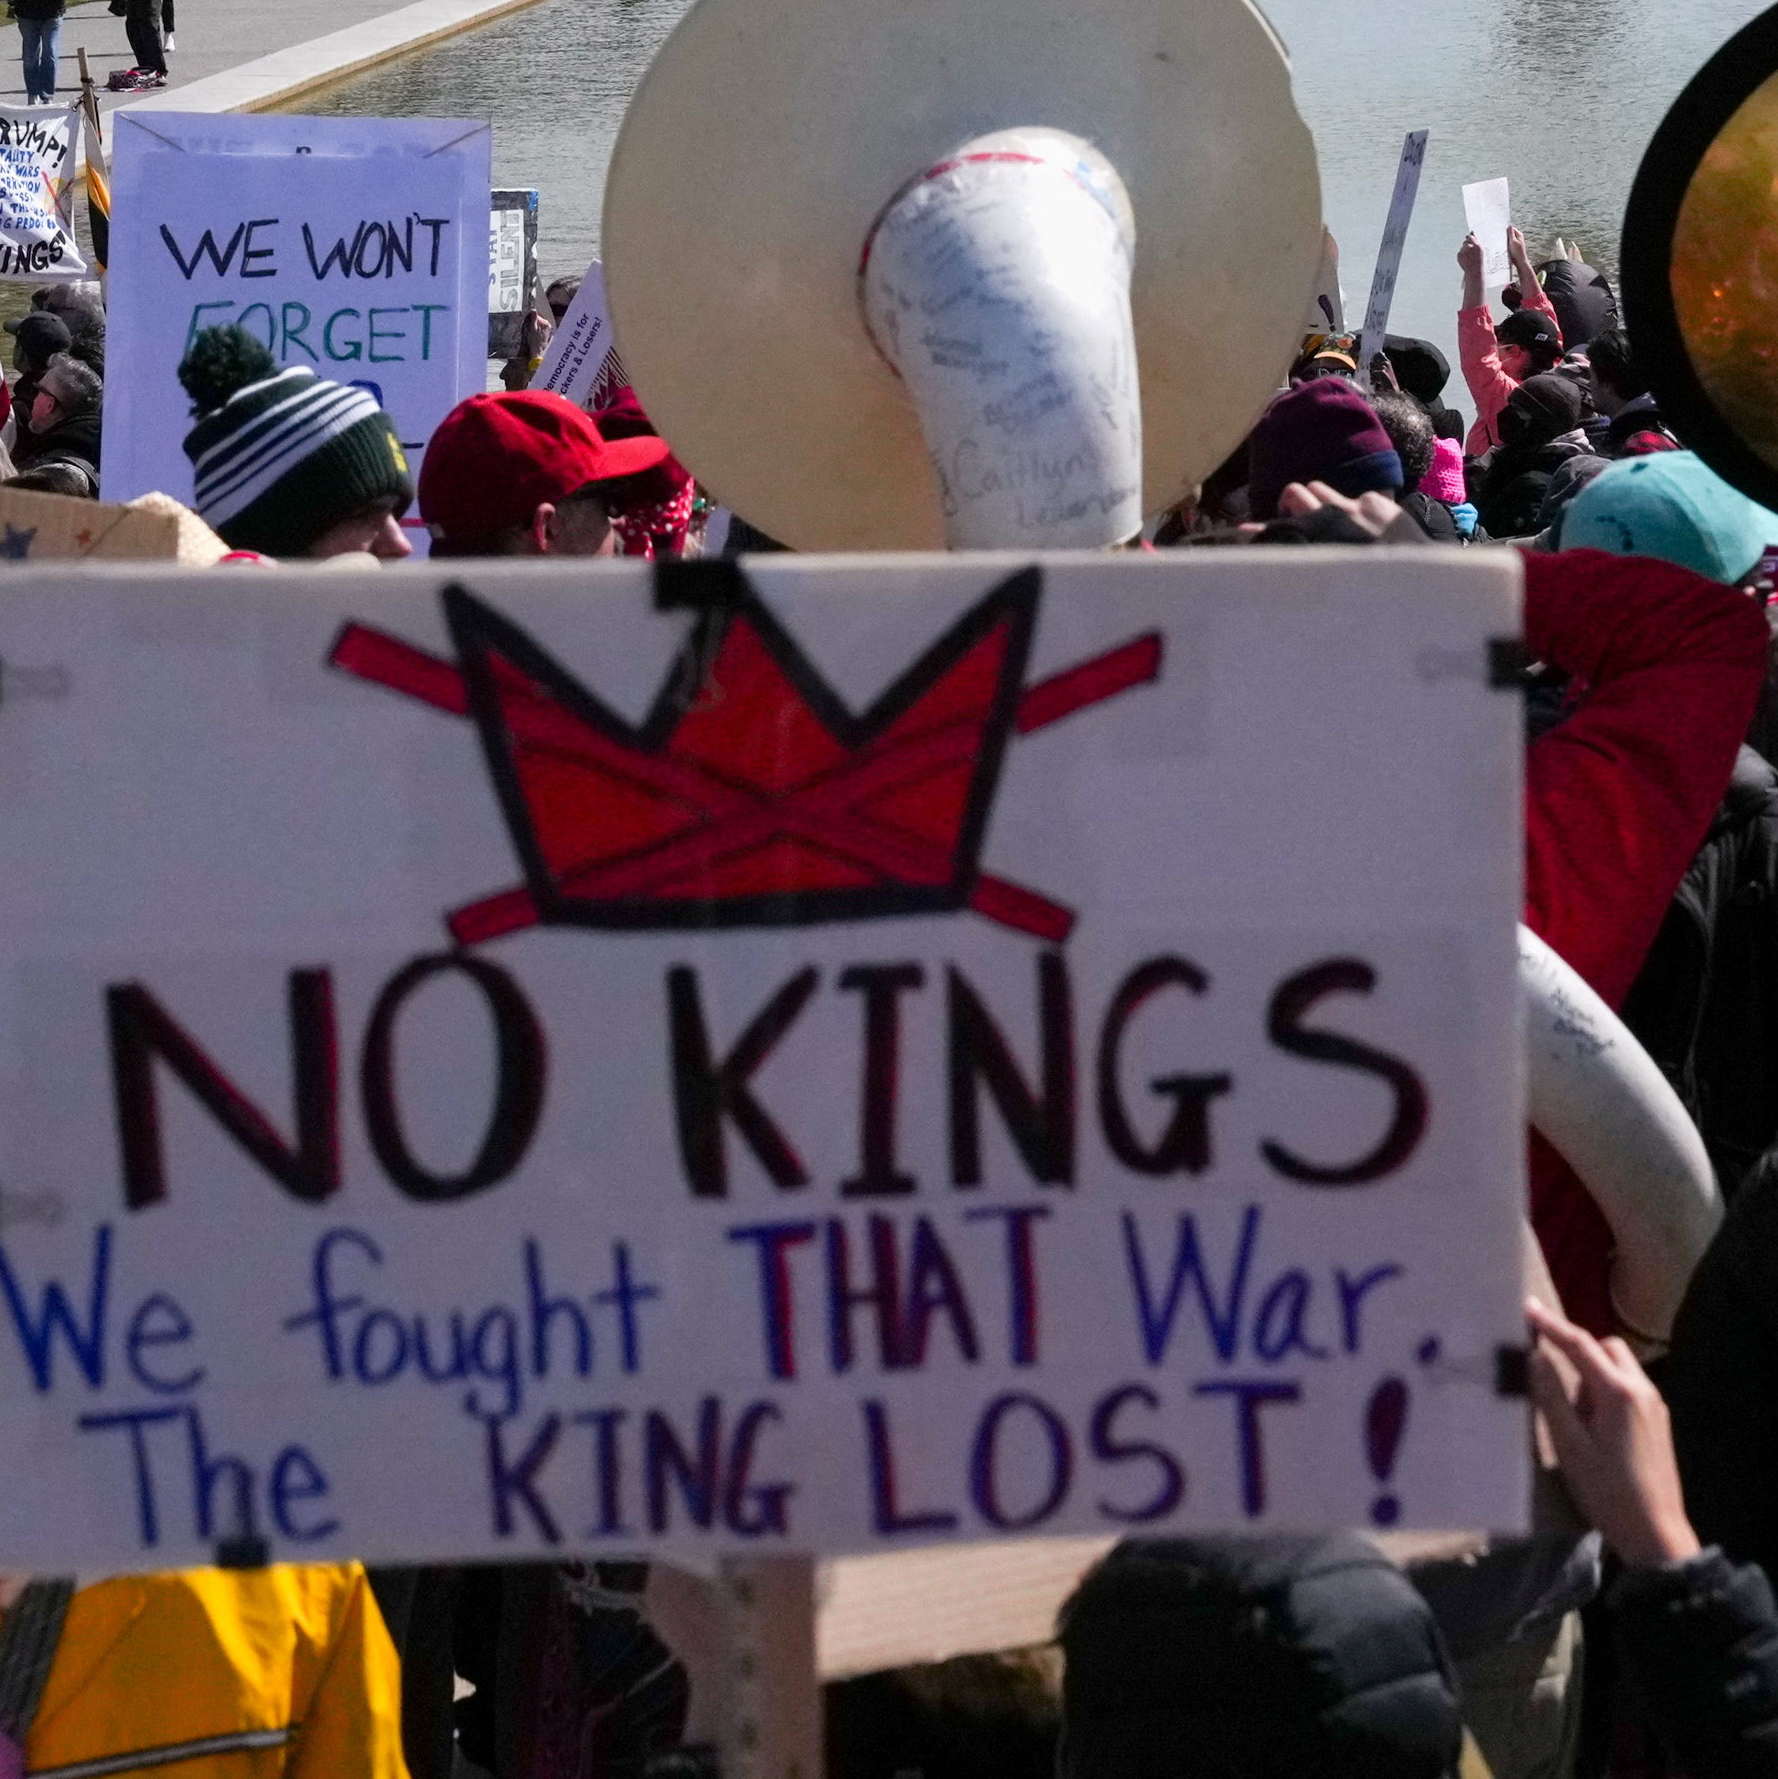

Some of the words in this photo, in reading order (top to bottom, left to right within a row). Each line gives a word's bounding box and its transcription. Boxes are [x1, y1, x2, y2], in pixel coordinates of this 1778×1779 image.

[15, 165, 40, 178] WARS
[158, 218, 279, 281] WE
[301, 211, 450, 281] WON'T
[558, 367, 579, 397] ckers
[579, 317, 603, 357] Losers!
[571, 329, 582, 341] is
[576, 312, 590, 330] for
[105, 948, 550, 1212] NO
[665, 948, 1434, 1202] KINGS
[283, 1226, 665, 1417] fought
[728, 1206, 1055, 1384] THAT
[1120, 1206, 1446, 1371] War.
[76, 1408, 344, 1548] The
[481, 1400, 798, 1544] KING
